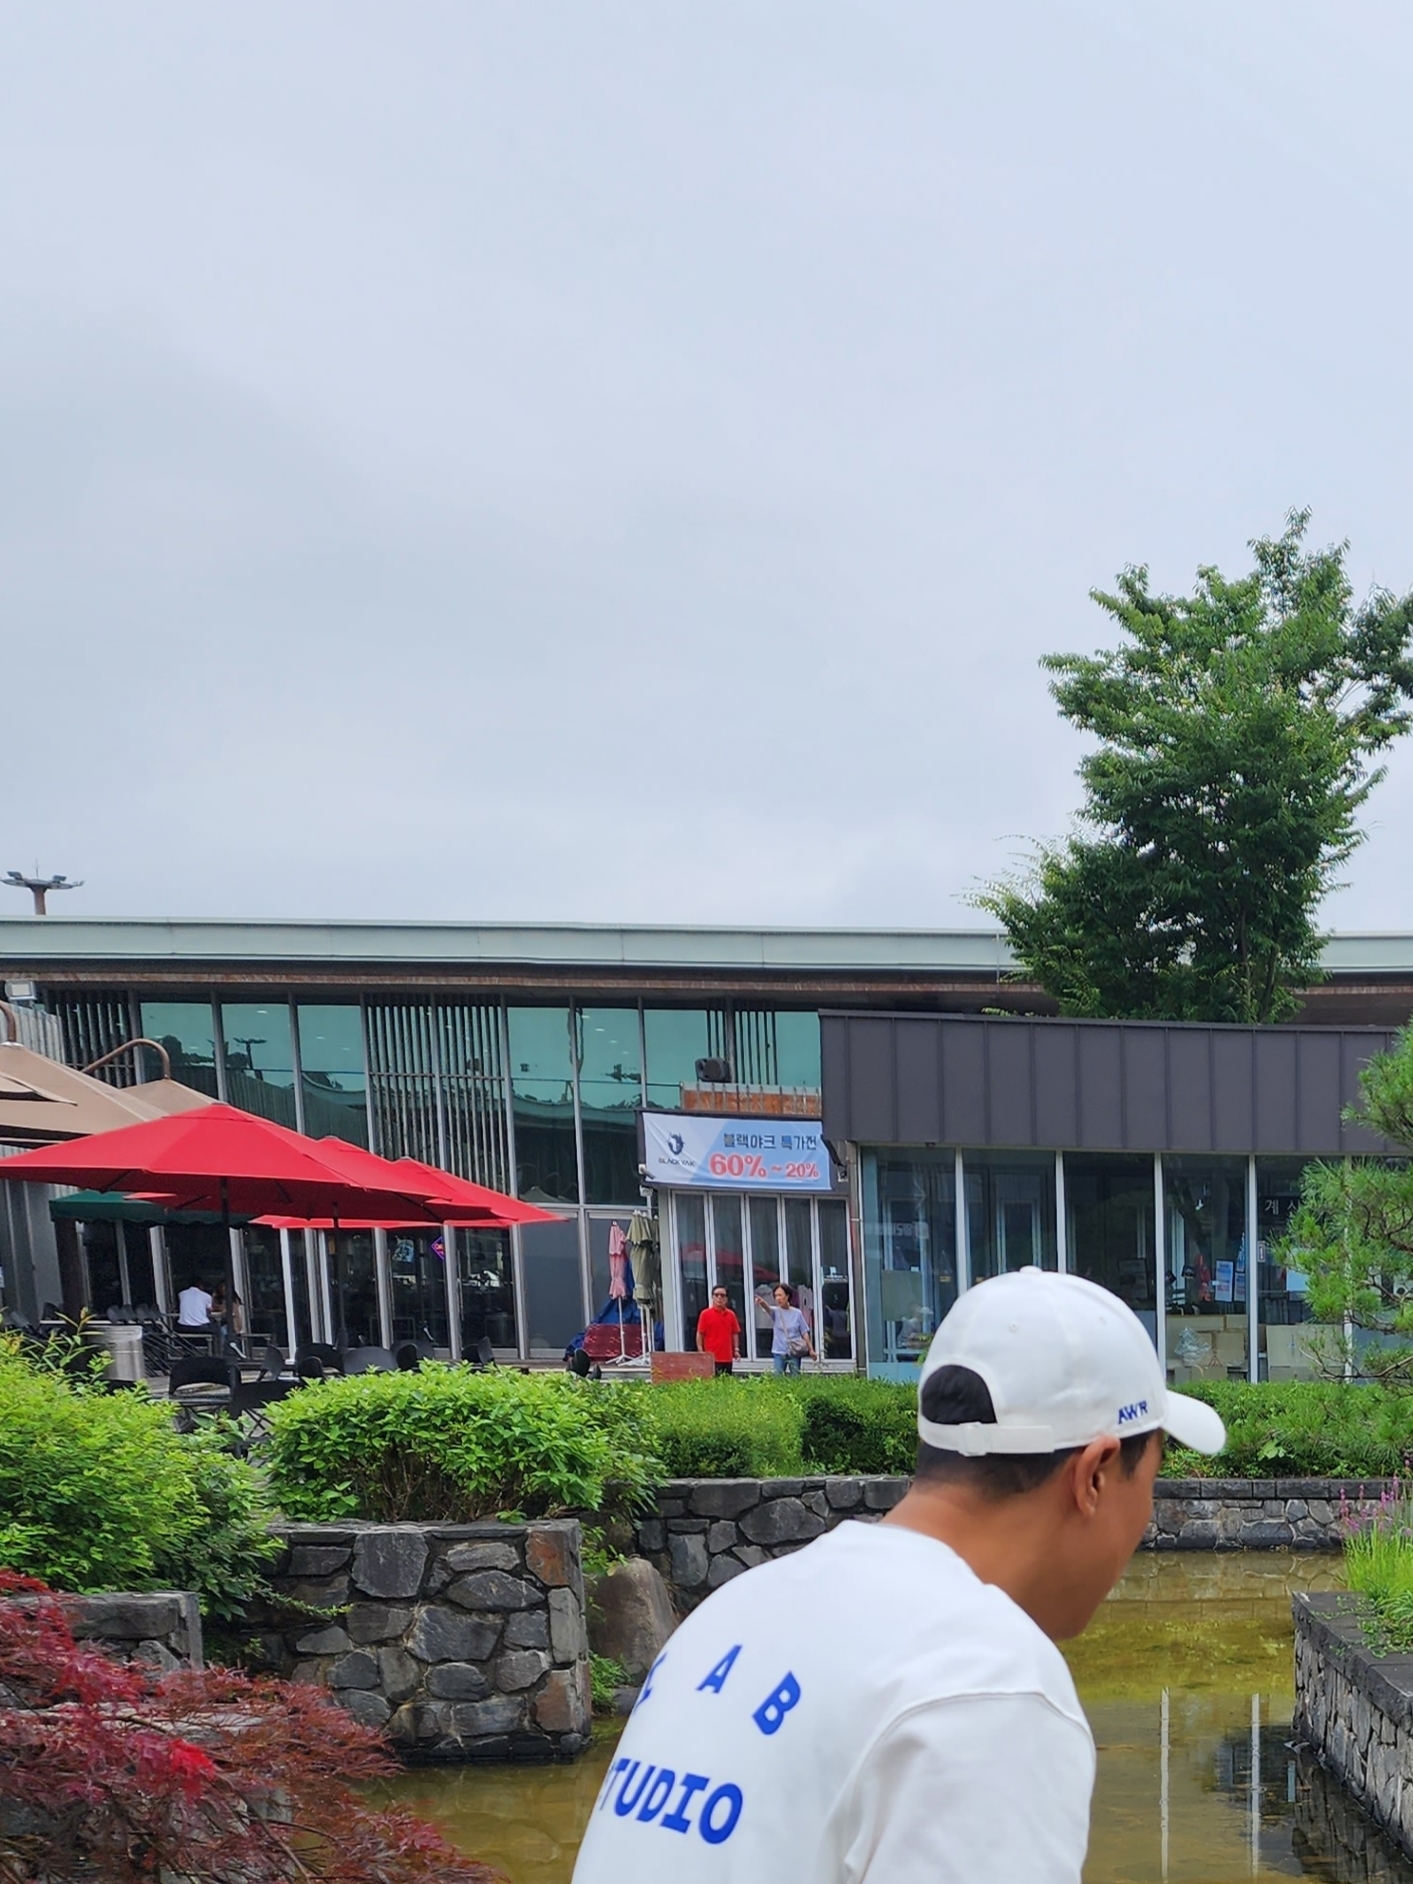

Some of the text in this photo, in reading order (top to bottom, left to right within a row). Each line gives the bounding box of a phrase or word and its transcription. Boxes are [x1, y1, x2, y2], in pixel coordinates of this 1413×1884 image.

[723, 1133, 817, 1150] 블랙야크 특가전
[709, 1152, 767, 1179] 60%
[785, 1162, 819, 1178] 20%
[599, 1757, 743, 1845] TUDIO
